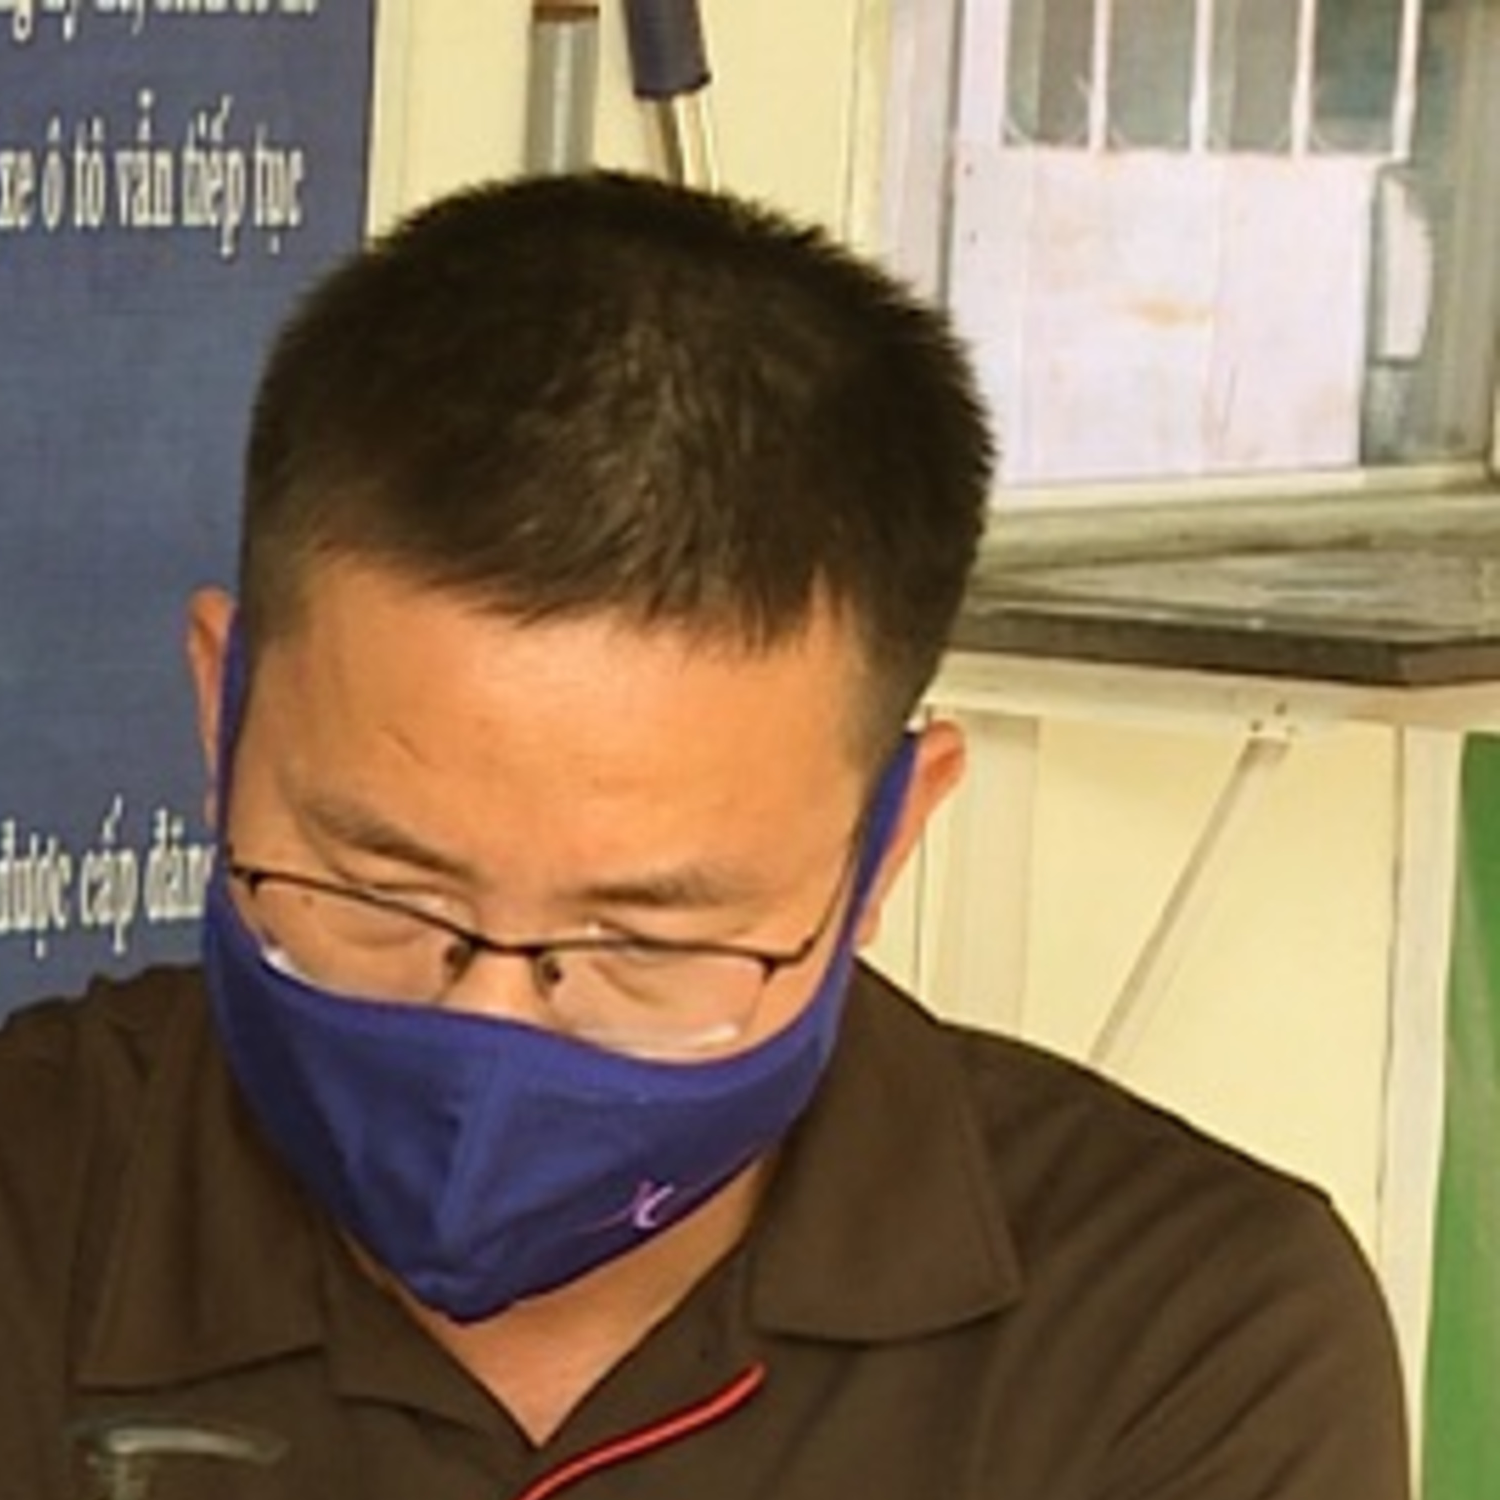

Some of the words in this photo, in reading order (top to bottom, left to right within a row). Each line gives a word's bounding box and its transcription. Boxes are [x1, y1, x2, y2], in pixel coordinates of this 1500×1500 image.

[41, 115, 65, 228] ô
[73, 115, 105, 228] tô
[116, 90, 173, 226] vẫn
[182, 94, 245, 257] tiếp
[255, 122, 303, 254] tục
[81, 795, 139, 955] cấp
